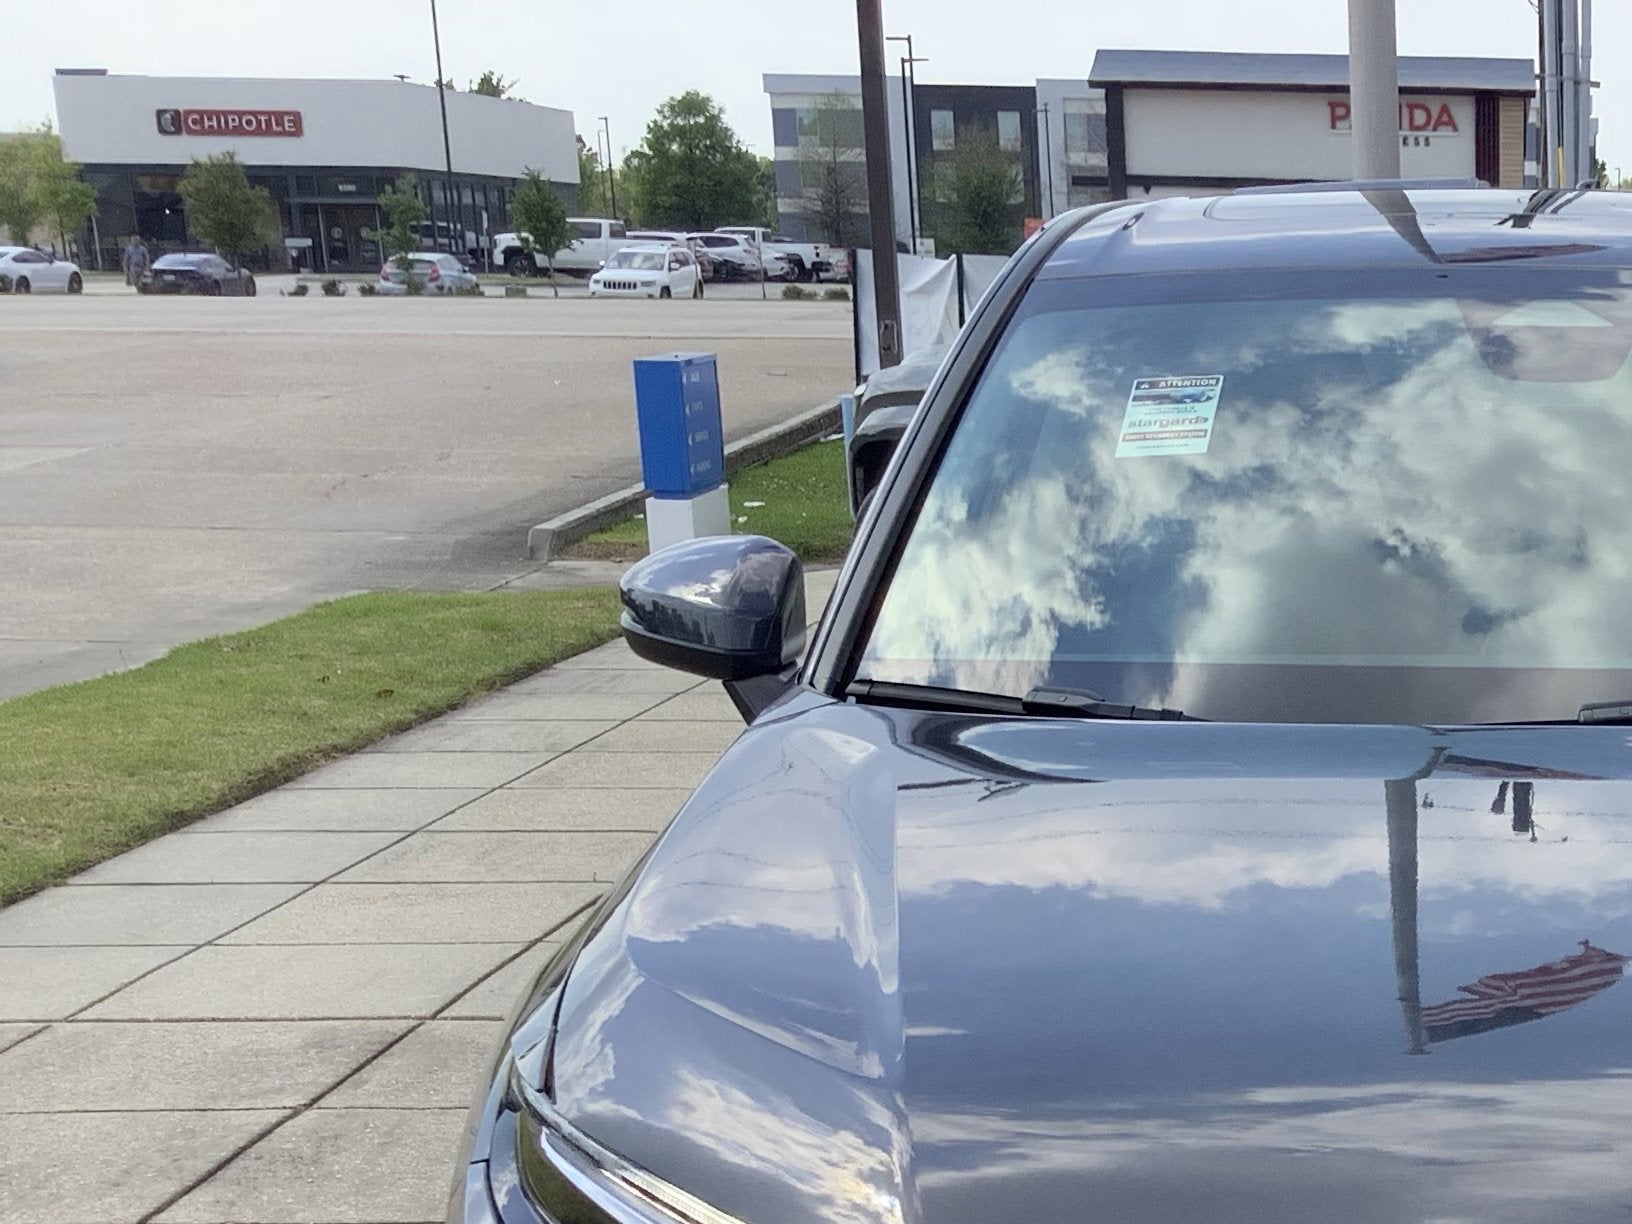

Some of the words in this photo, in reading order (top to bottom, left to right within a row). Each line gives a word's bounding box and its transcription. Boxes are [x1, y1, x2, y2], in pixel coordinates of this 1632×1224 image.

[187, 113, 297, 132] CHIPOTLE
[1328, 101, 1459, 132] PDA
[1158, 378, 1217, 388] ATTENTION
